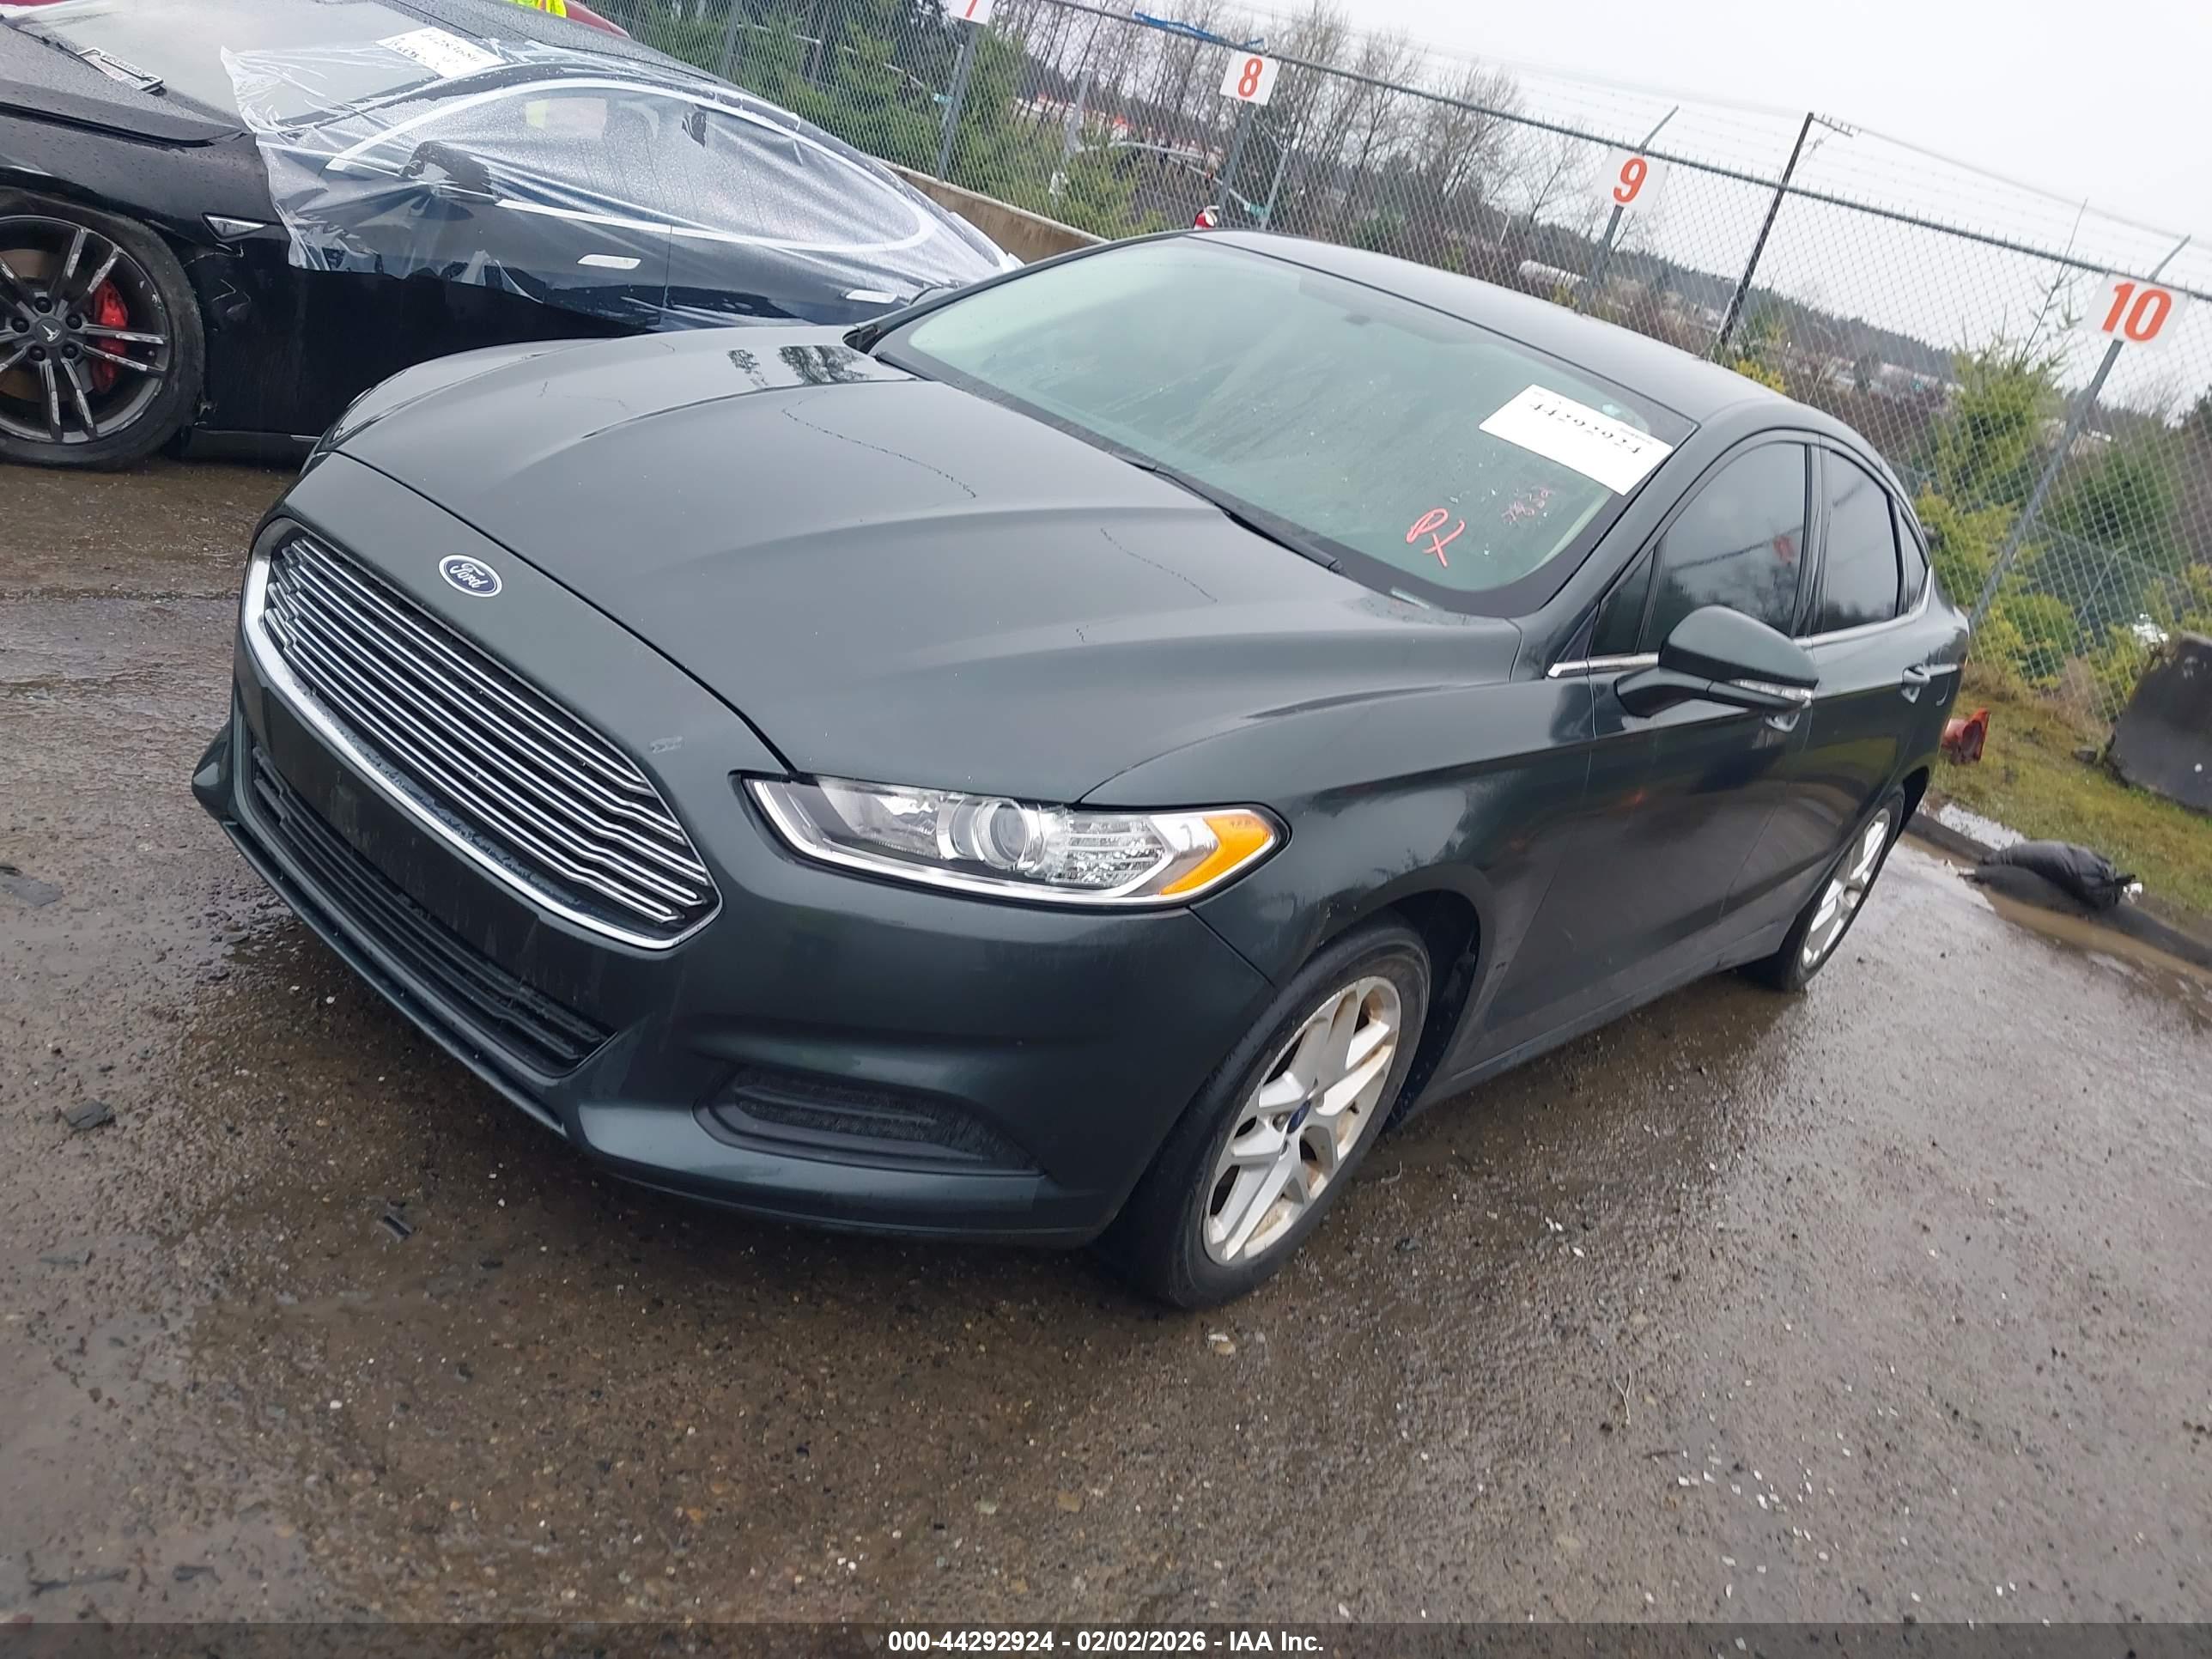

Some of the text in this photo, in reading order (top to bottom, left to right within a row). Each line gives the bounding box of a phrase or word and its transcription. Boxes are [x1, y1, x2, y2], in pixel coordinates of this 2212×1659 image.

[1237, 58, 1263, 97] 8
[1613, 158, 1647, 203] 9
[2101, 283, 2172, 342] 10
[449, 562, 489, 588] Ford
